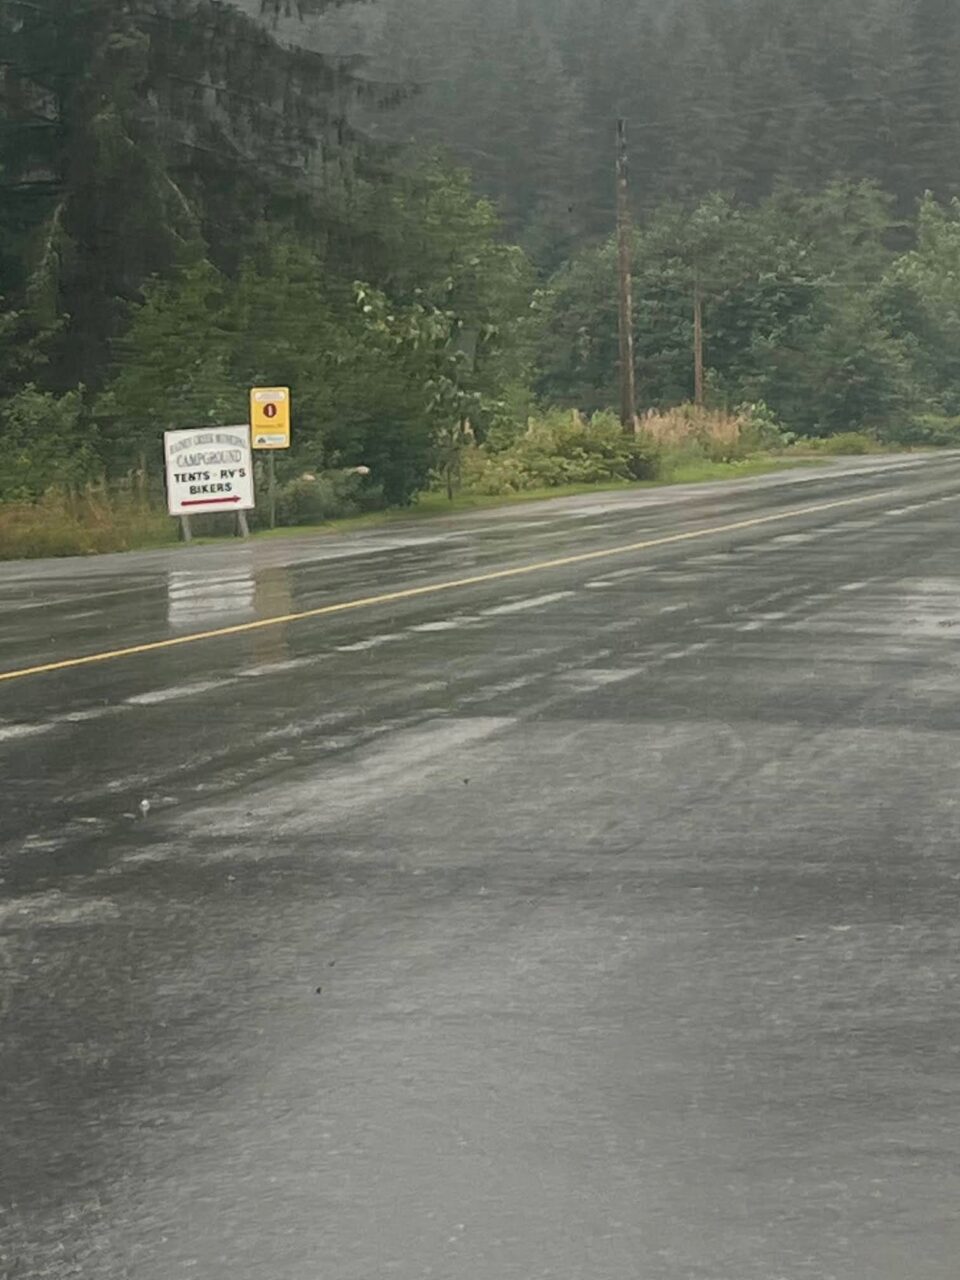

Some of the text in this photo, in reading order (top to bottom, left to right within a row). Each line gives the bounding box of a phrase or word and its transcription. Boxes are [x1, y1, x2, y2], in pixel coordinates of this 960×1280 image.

[176, 450, 242, 468] CAMPGROUND
[174, 471, 210, 483] TENTS
[189, 483, 232, 495] BIKERS
